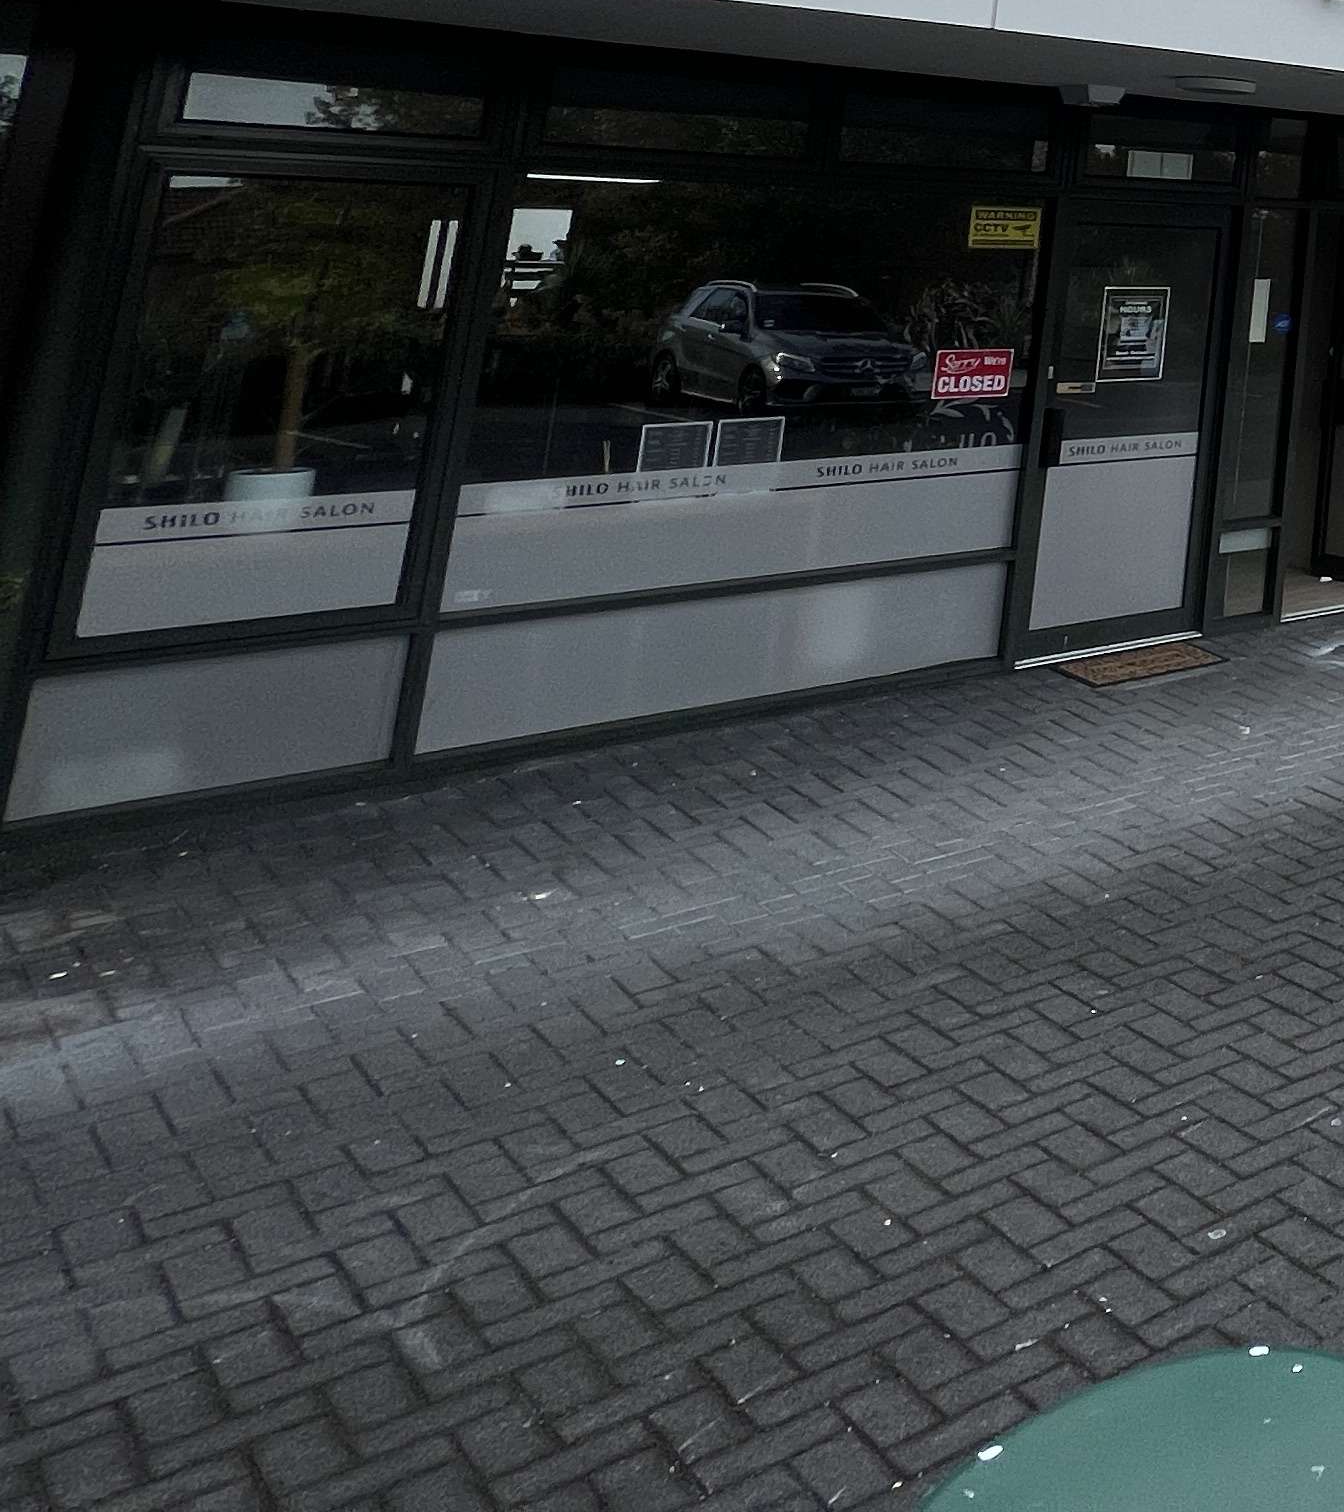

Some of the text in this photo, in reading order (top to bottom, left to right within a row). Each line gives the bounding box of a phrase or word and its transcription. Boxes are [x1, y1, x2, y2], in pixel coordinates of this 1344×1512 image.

[973, 222, 1009, 233] CCTV
[937, 374, 1006, 394] CLOSED
[1067, 439, 1183, 457] SHILO HAIR SALON
[816, 456, 959, 478] SHILO HAIR SALON
[143, 511, 221, 530] SHILO
[300, 501, 376, 520] SALON
